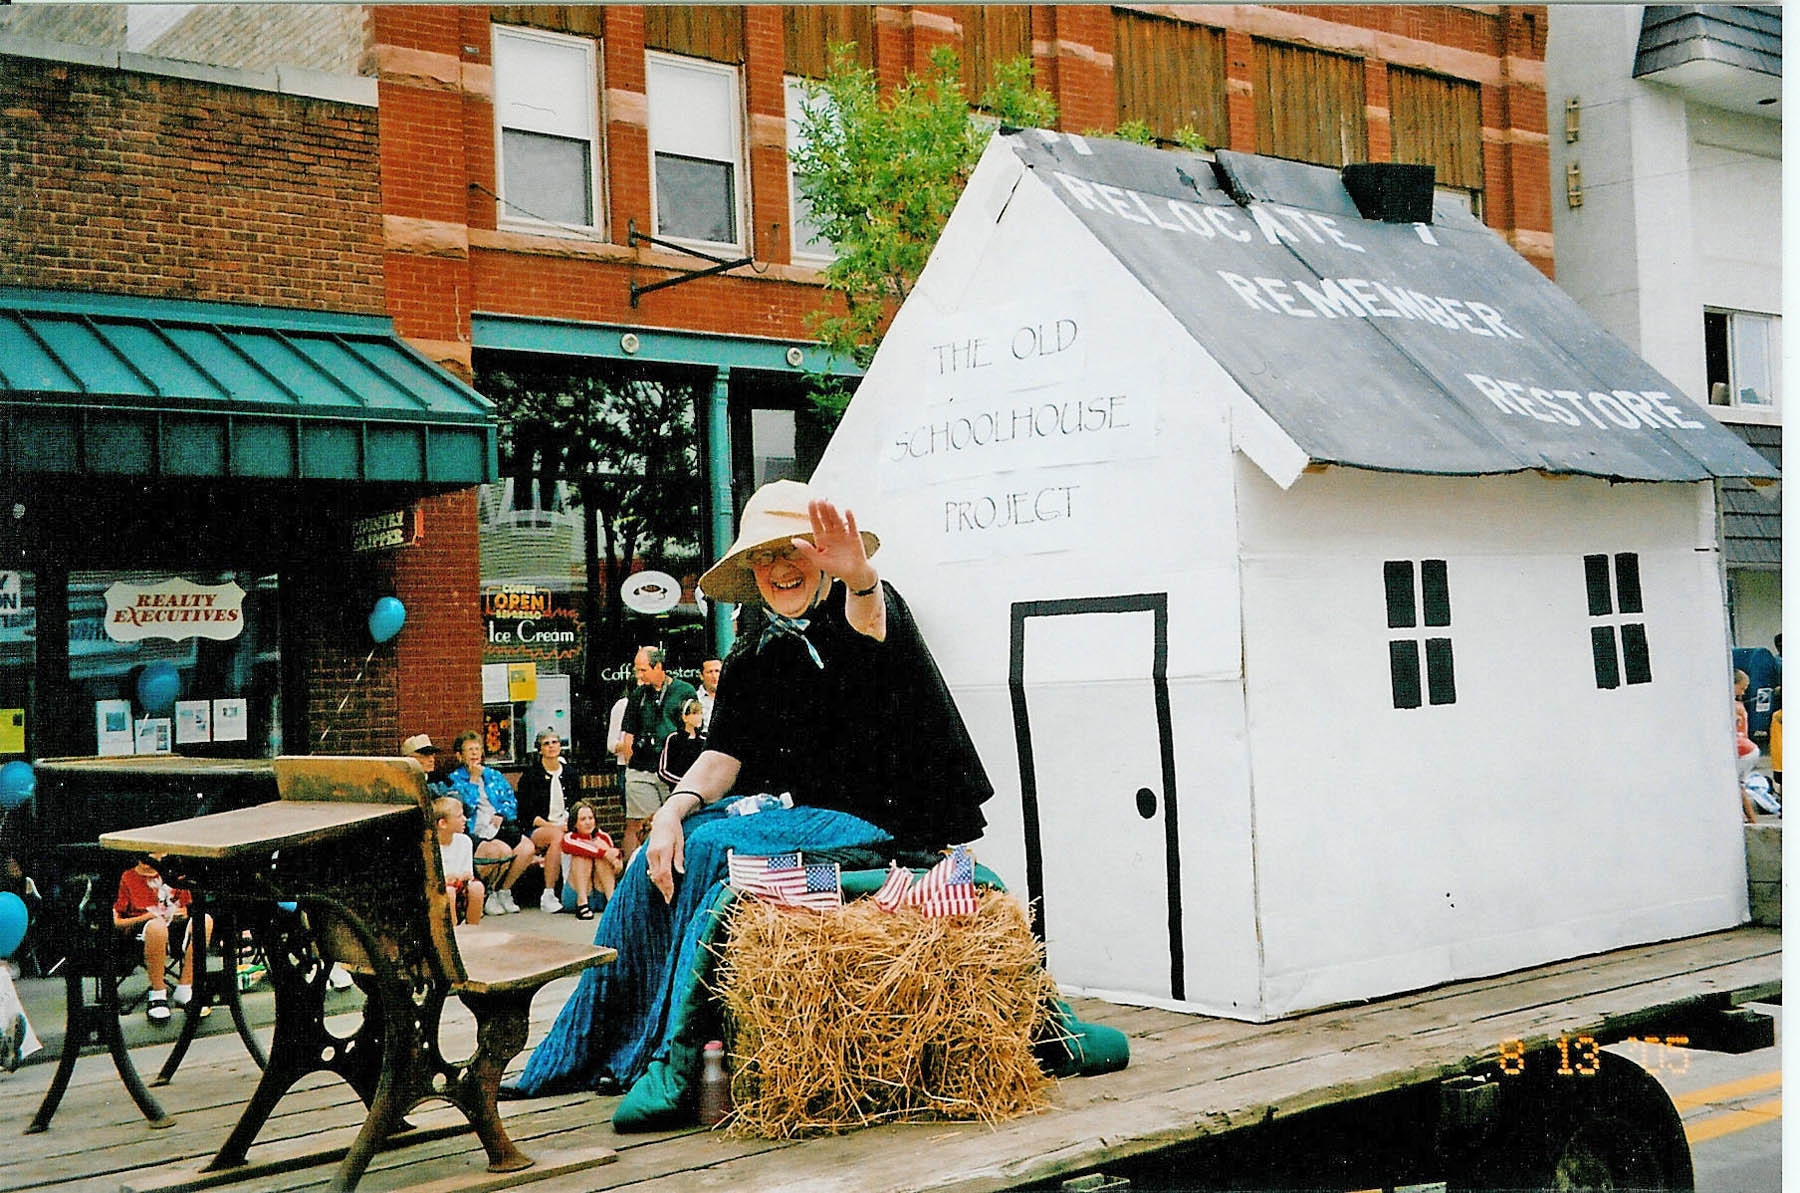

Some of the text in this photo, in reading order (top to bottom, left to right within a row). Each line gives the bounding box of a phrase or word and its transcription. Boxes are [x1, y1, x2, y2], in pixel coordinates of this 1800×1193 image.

[1053, 171, 1366, 254] RELOCATE
[1216, 268, 1525, 340] REMEMBER
[932, 318, 1078, 375] THE OLD
[1465, 372, 1705, 431] RESTORE
[889, 395, 1131, 463] SCHOOLHOUSE
[945, 484, 1081, 533] PROJECT
[112, 605, 239, 627] EXECUTIVES
[135, 593, 218, 608] REALTY
[494, 592, 545, 610] OPEN
[488, 619, 575, 643] Ice Cream
[601, 662, 702, 681] Coff sters
